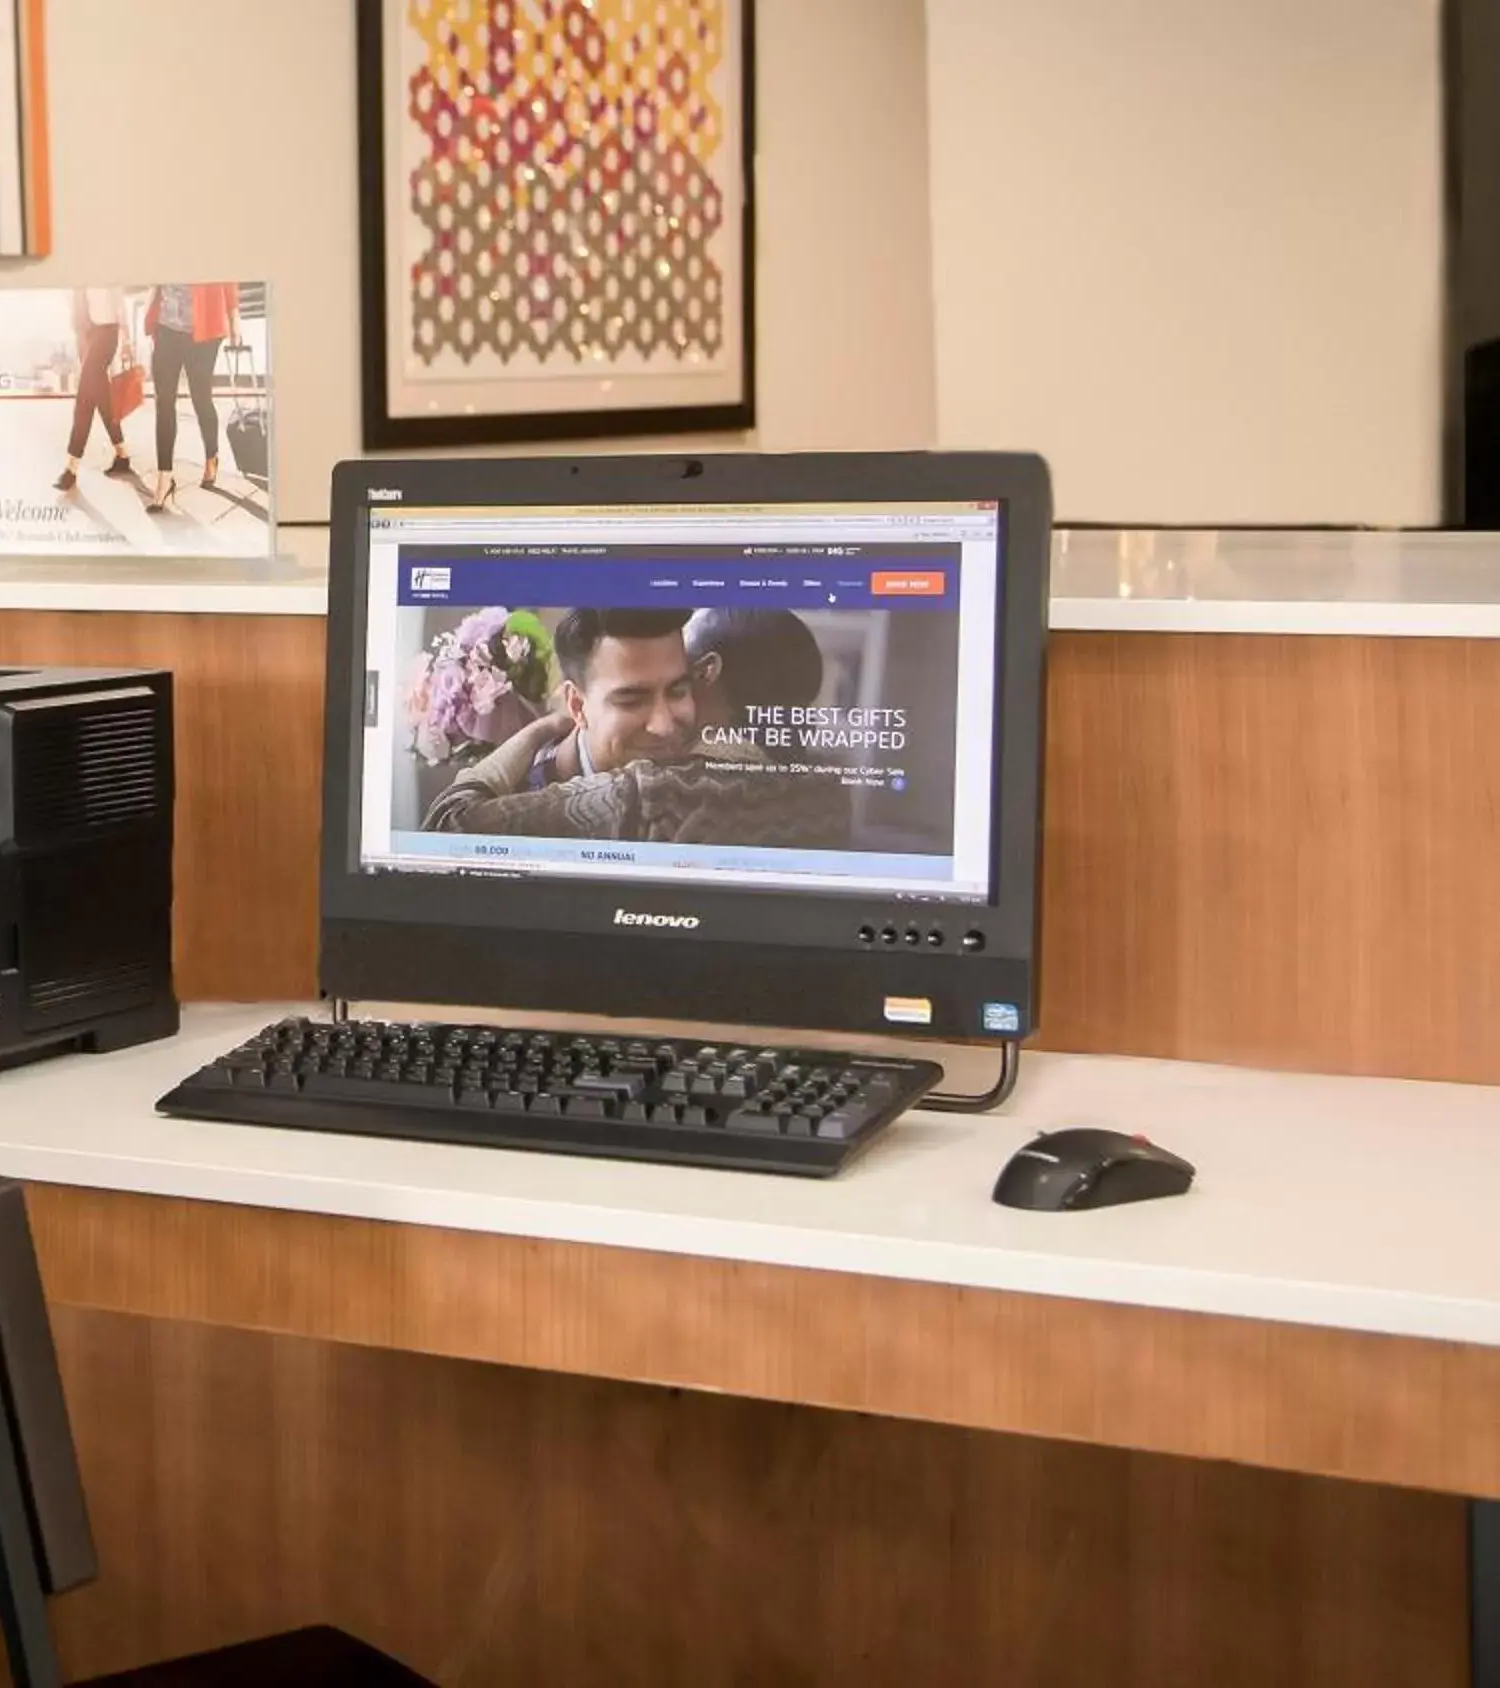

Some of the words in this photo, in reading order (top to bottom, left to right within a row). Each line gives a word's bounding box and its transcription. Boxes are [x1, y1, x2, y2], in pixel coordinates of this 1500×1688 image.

[745, 705, 785, 725] THE
[791, 707, 841, 726] BEST
[848, 708, 907, 728] GIFTS
[701, 726, 759, 745] CAN'T
[765, 728, 792, 747] BE
[798, 729, 906, 750] WRAPPED
[613, 908, 700, 929] lenovo
